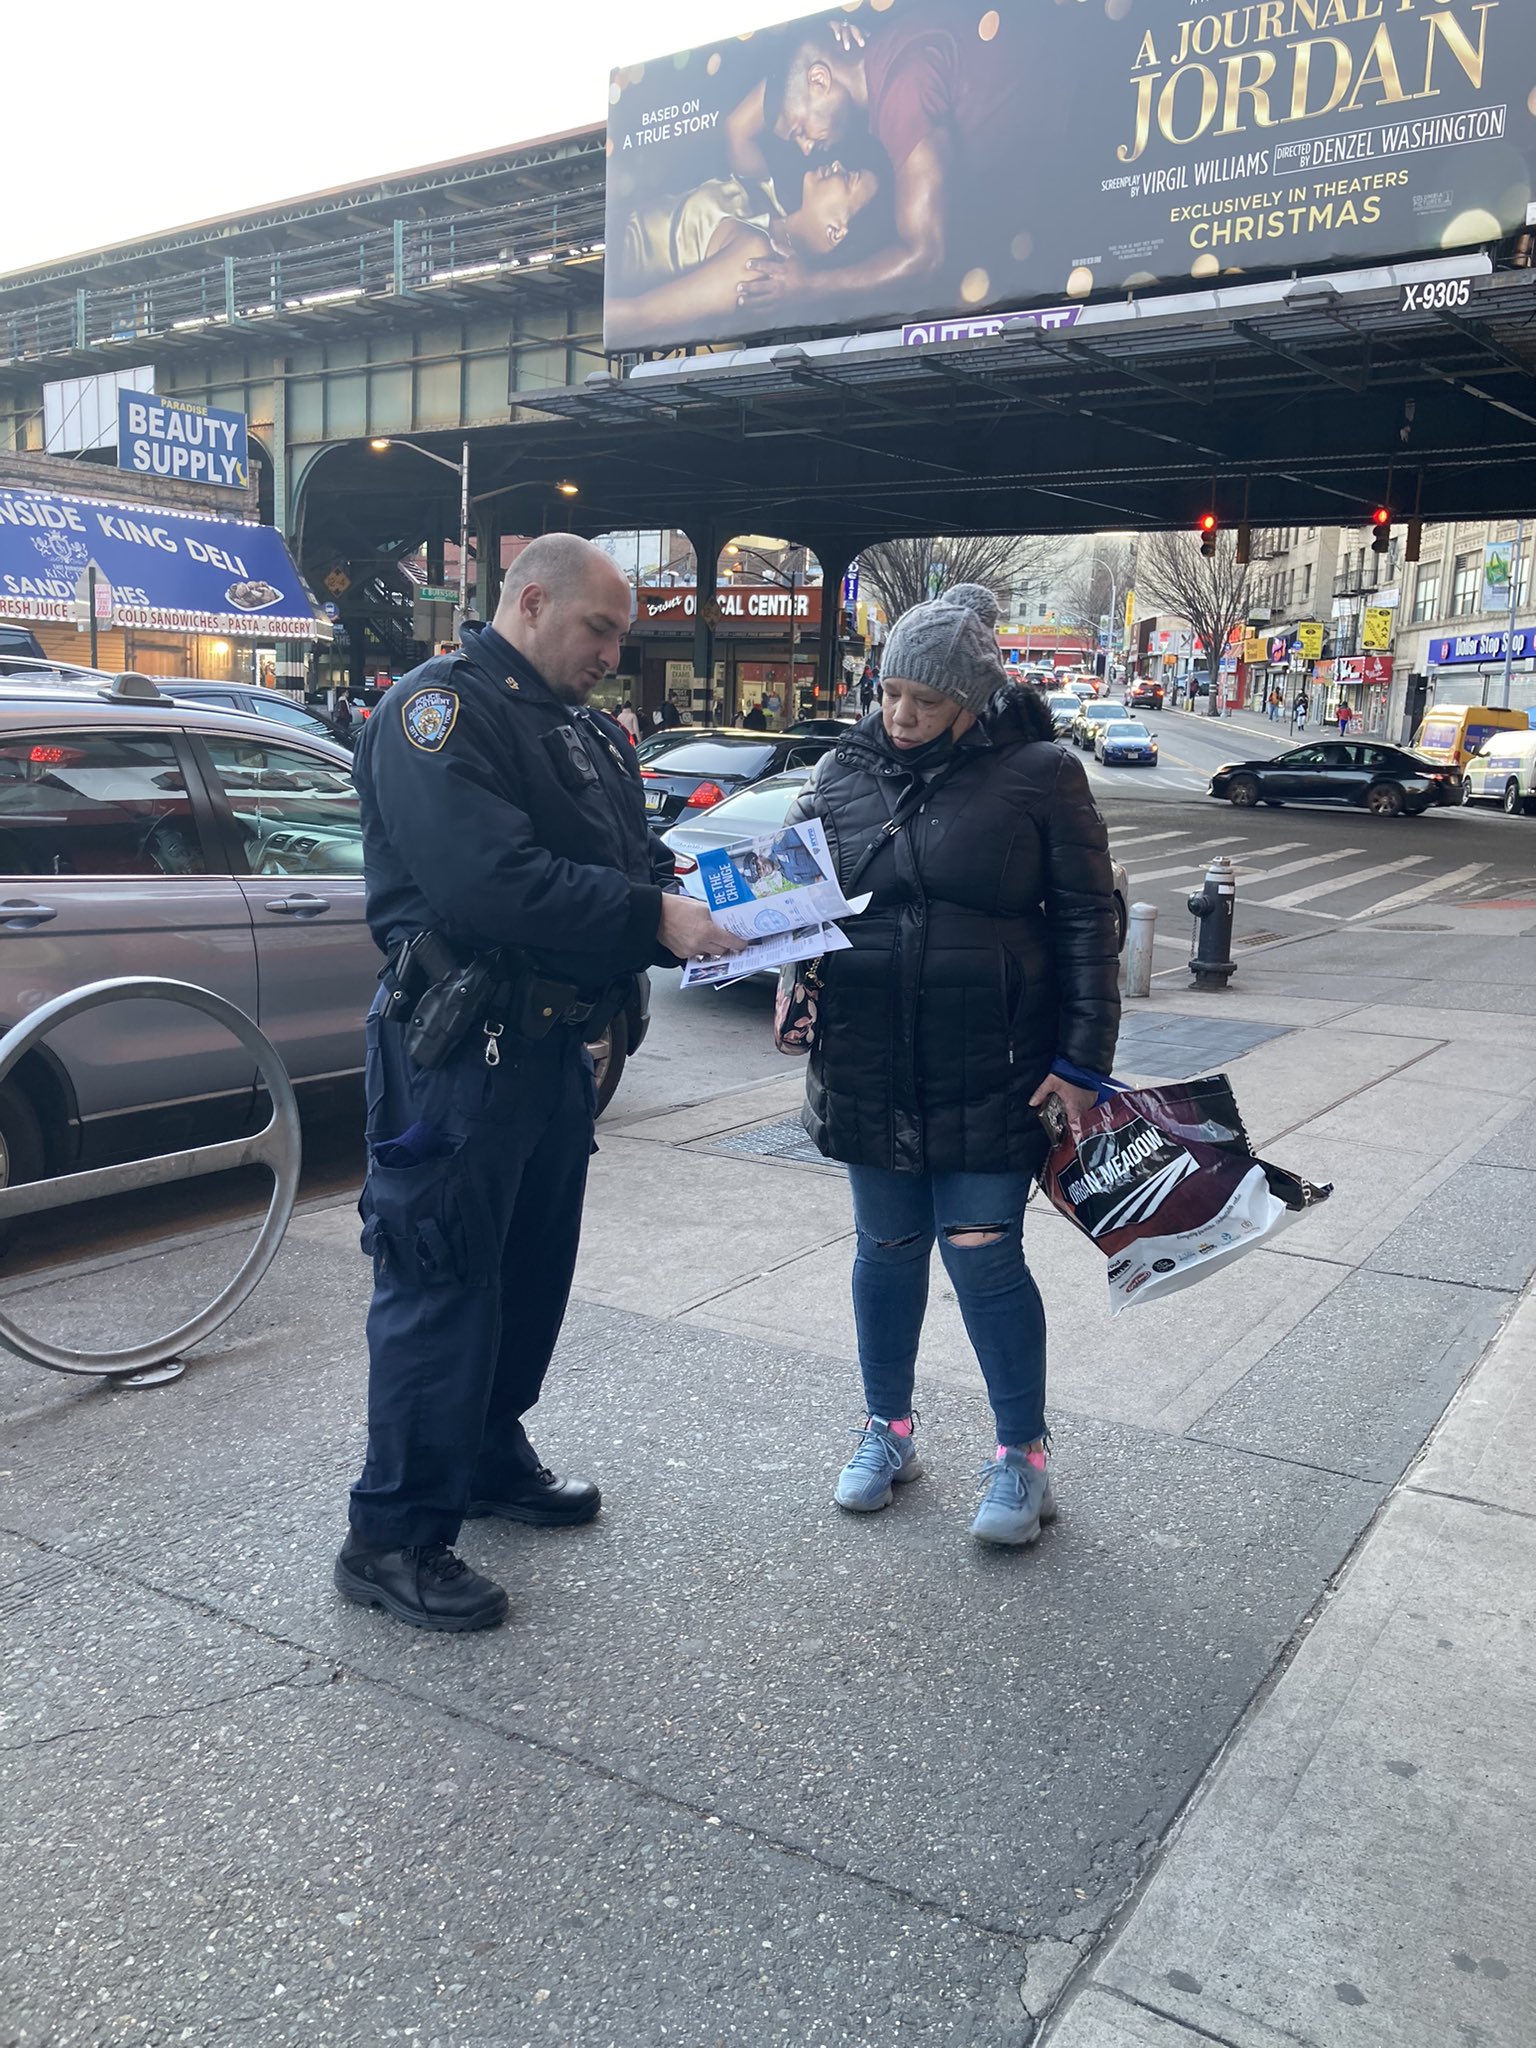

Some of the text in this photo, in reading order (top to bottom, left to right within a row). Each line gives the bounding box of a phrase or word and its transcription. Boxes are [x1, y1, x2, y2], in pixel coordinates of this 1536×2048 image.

[1131, 29, 1160, 69] A
[1116, 2, 1500, 163] JORDAN
[622, 111, 719, 149] A TRUE STORY
[641, 98, 700, 126] BASED ON
[1276, 107, 1505, 166] DIRECTED DENZEL WASHINGTON
[1101, 149, 1270, 195] SCREENPLAY VIRGIL WILLIAMS
[1299, 154, 1311, 168] BY
[1130, 184, 1140, 198] BY
[1170, 169, 1410, 223] EXCLUSIVELY IN THEATERS
[1189, 195, 1382, 251] CHRISTMAS
[1402, 279, 1471, 312] X-9305
[160, 398, 208, 417] PARADISE
[128, 402, 239, 451] BEAUTY
[132, 439, 239, 485] SUPPLY
[96, 512, 179, 553] KING
[184, 536, 250, 579] DELI
[35, 603, 68, 618] JUICE
[118, 609, 148, 624] COLD
[151, 612, 220, 629] SANDWICHES
[228, 617, 260, 632] PASTA
[268, 620, 312, 635] GROCERY
[748, 594, 809, 617] CENTER
[1455, 632, 1525, 658] Dollar Stop Sop
[408, 698, 451, 721] DEPARTMENT
[415, 692, 441, 706] POLICE
[408, 708, 453, 744] CITY OF NEW YORK
[708, 872, 727, 905] BE THE
[718, 862, 739, 903] CHANGE
[1068, 1126, 1165, 1206] URBAN MEADOW
